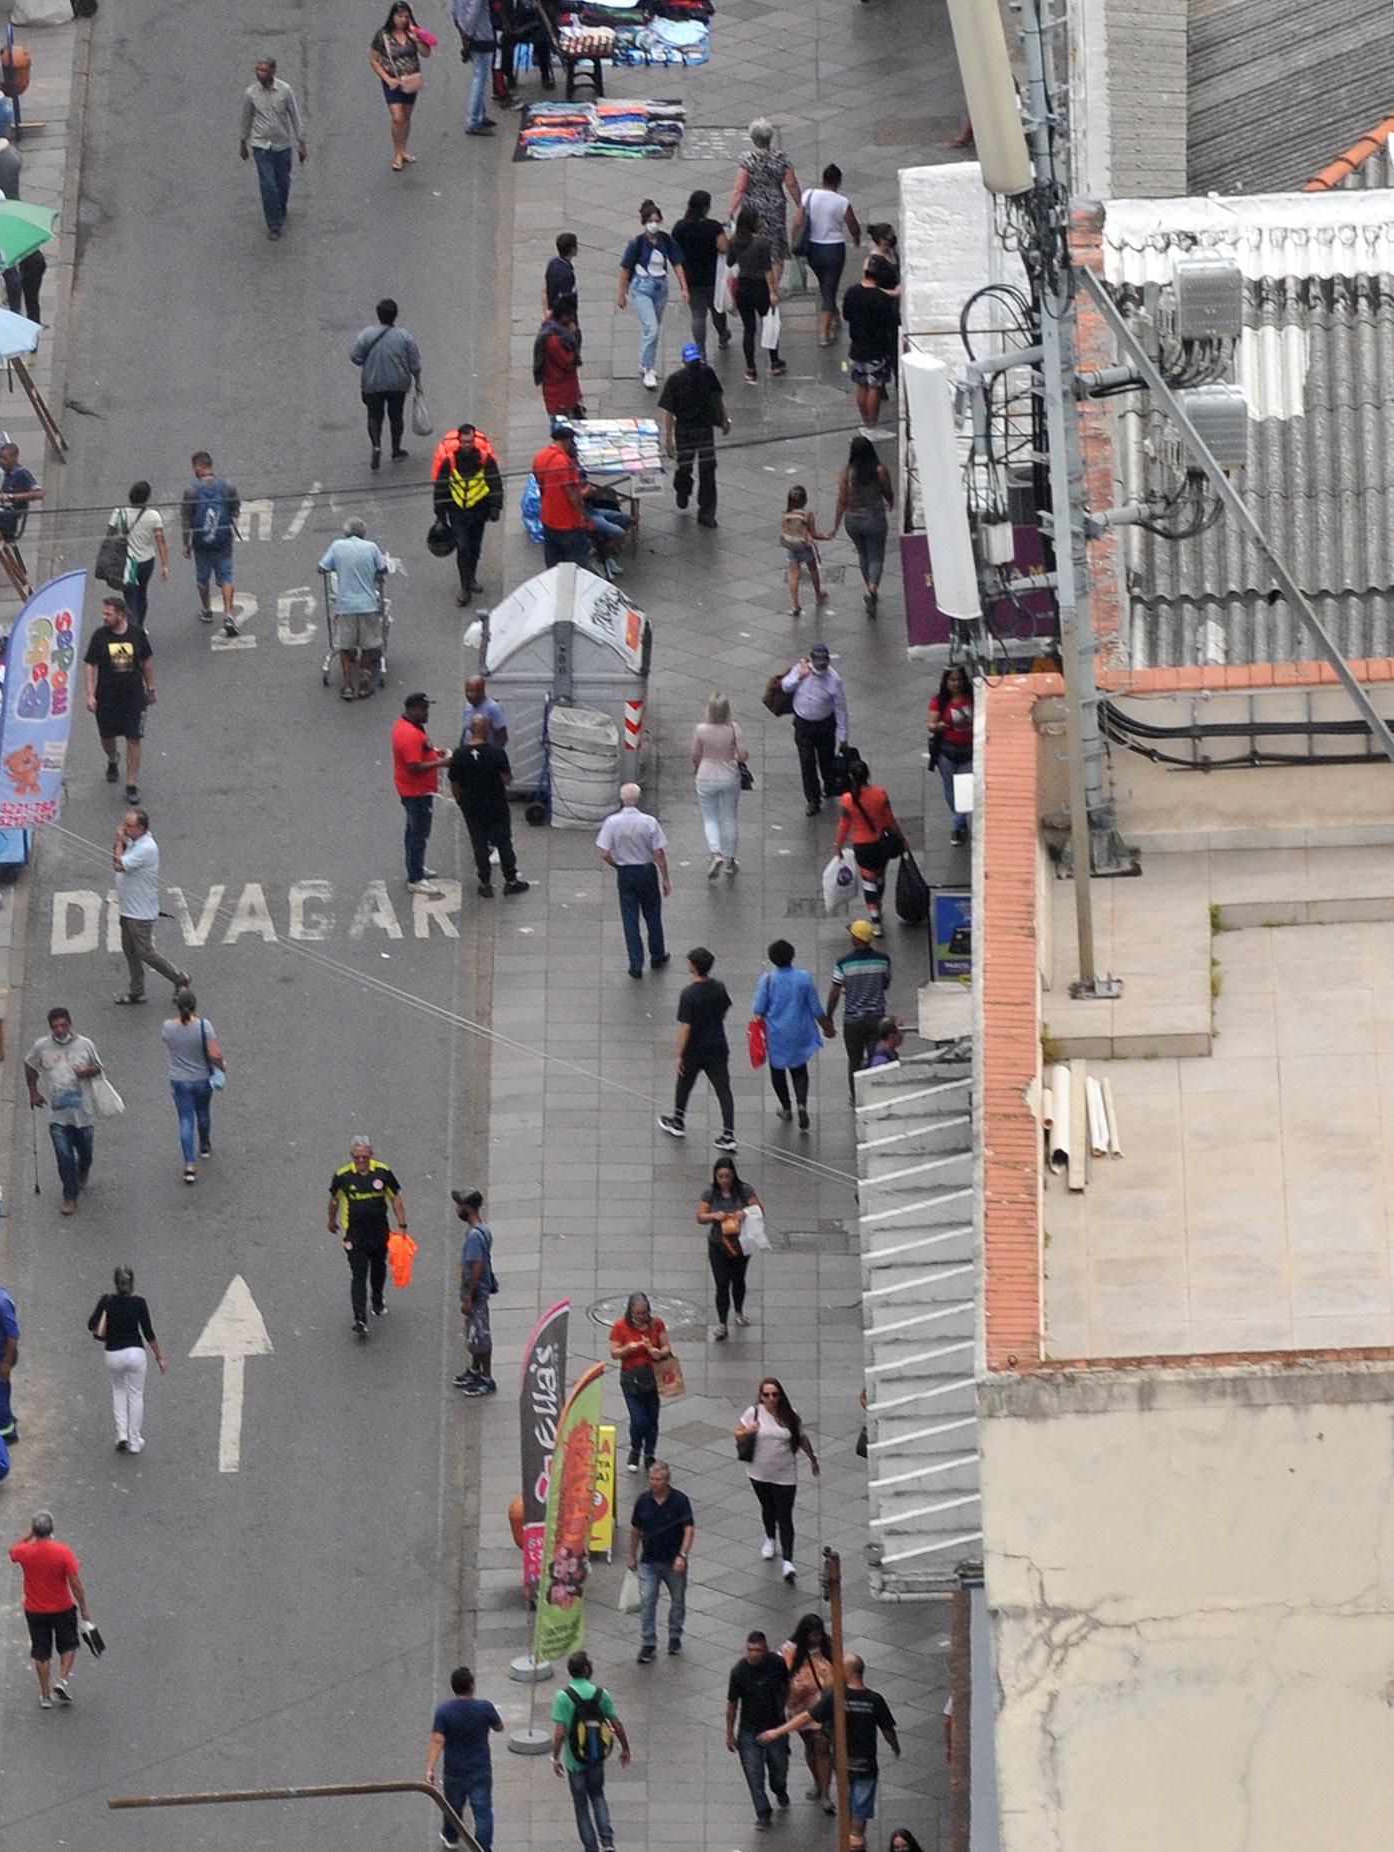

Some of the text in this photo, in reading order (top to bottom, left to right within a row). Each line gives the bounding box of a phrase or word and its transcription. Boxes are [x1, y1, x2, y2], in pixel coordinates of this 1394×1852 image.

[17, 618, 53, 719] Baby
[51, 611, 74, 715] modas
[528, 1344, 557, 1450] Ella's
